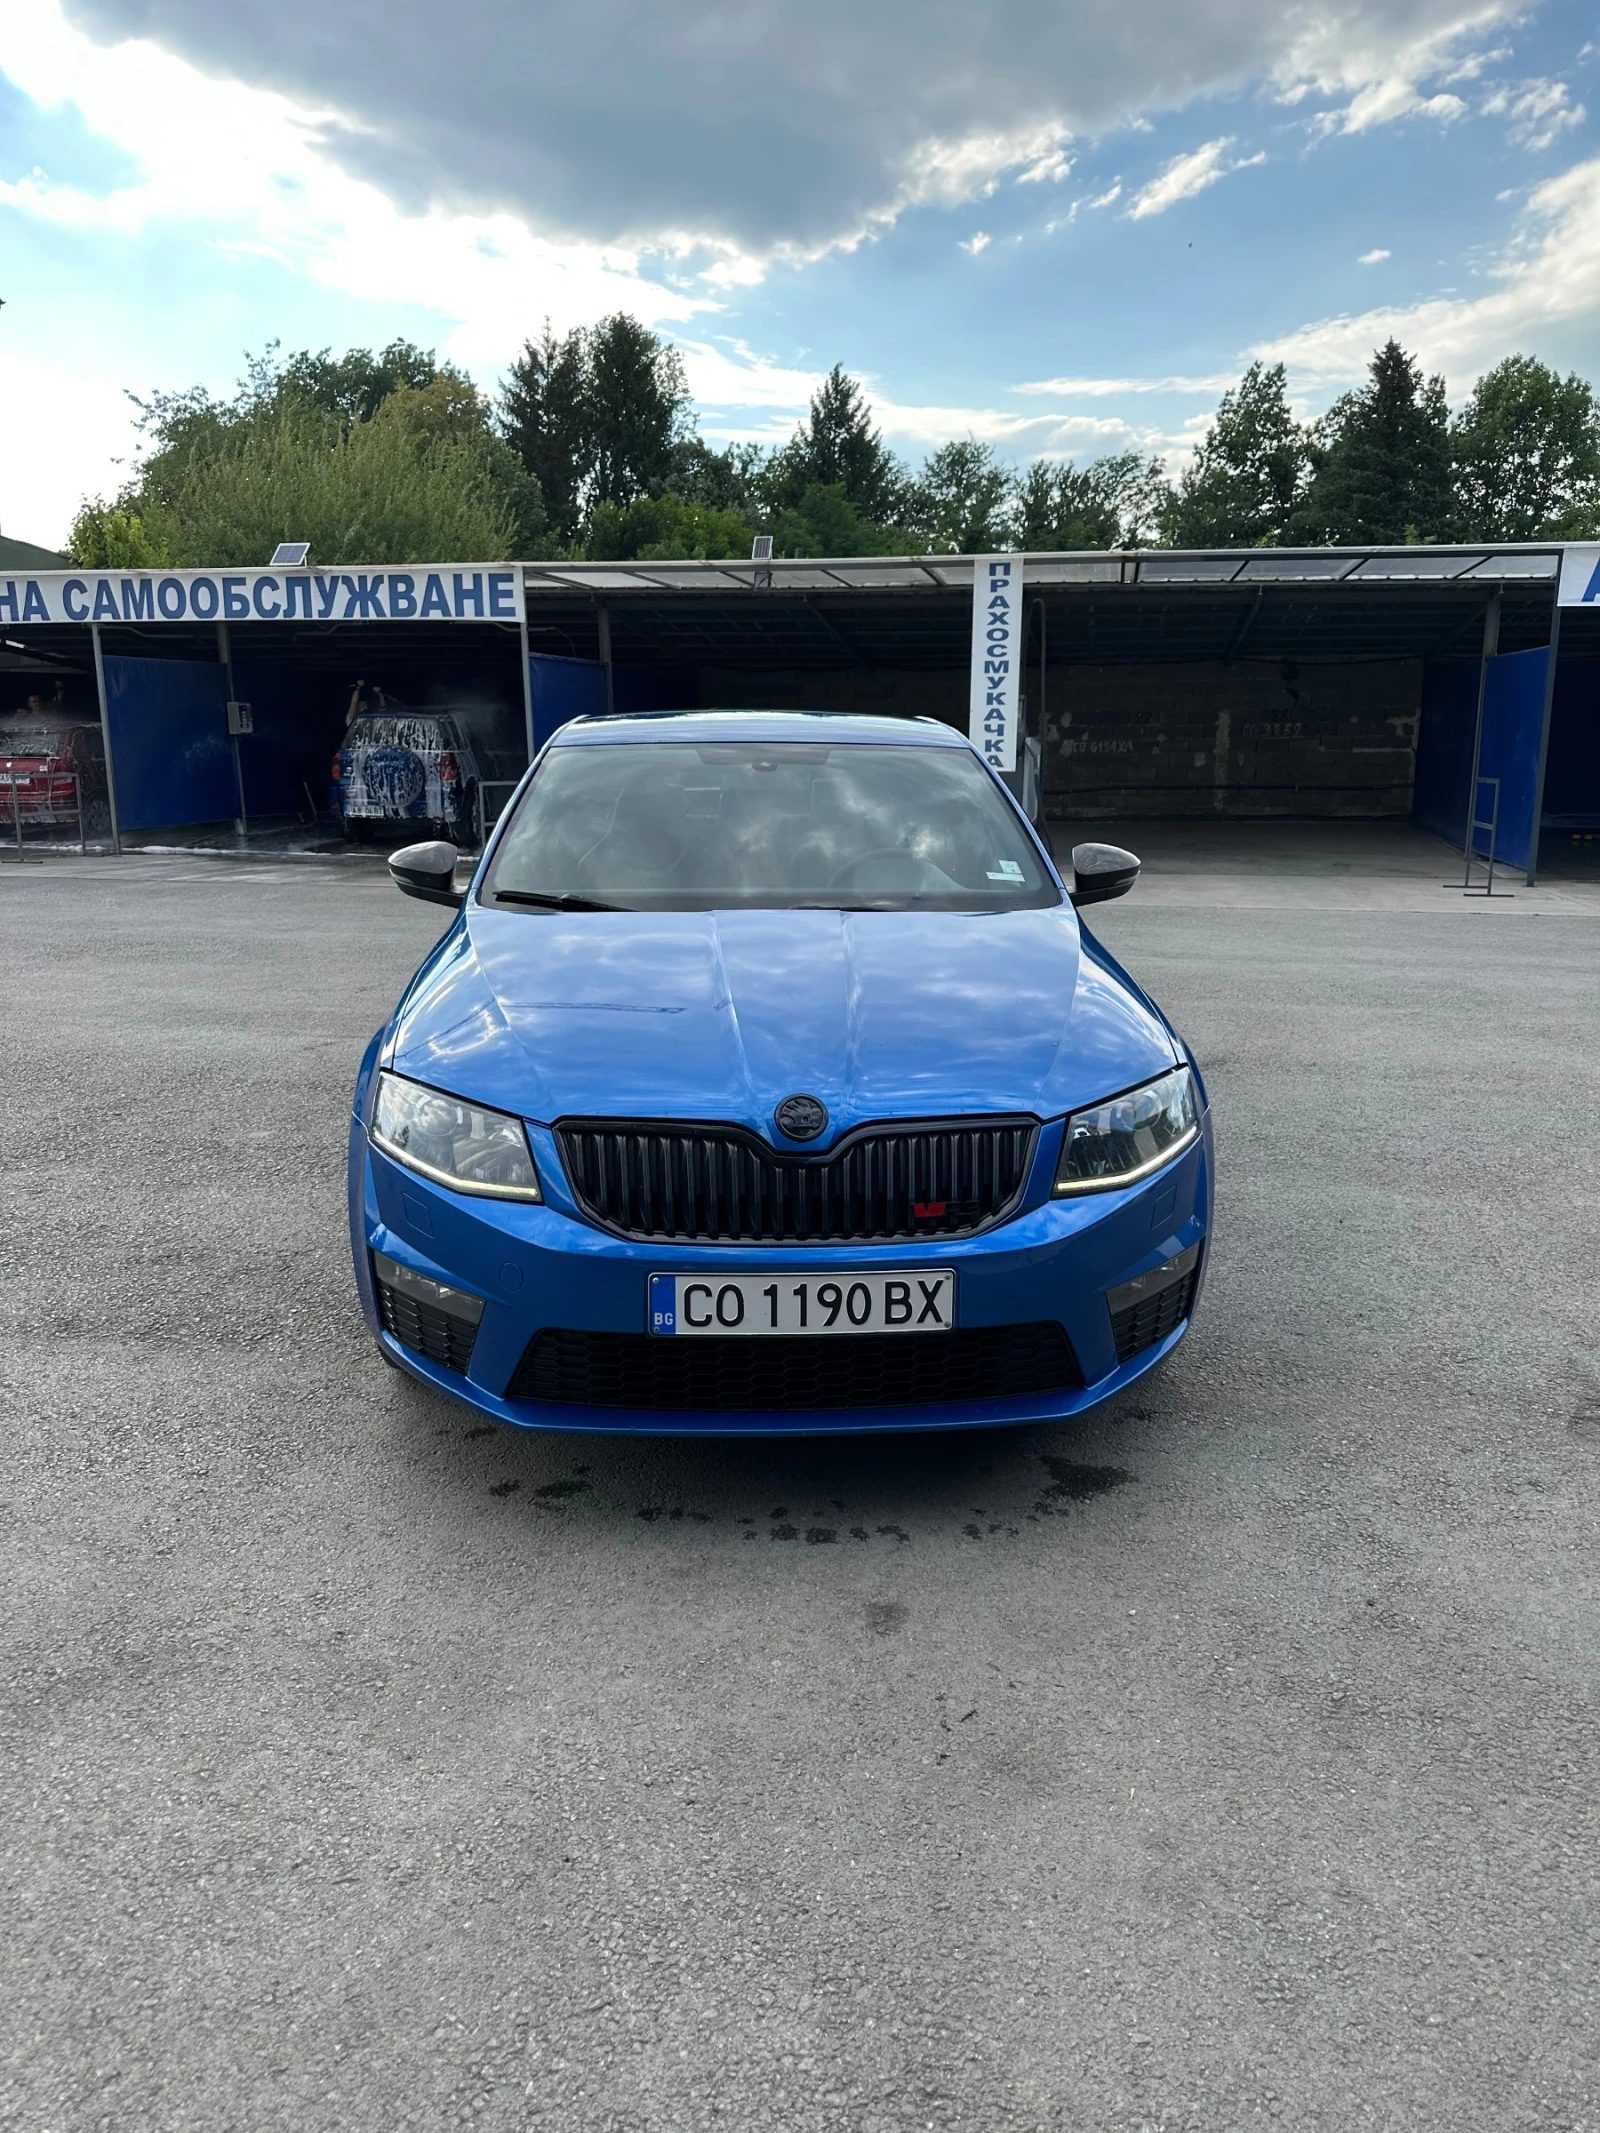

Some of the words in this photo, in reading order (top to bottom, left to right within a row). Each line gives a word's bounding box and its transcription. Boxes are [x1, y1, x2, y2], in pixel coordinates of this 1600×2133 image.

[62, 573, 516, 620] САМООБСЛУЖВАНЕ
[983, 562, 1011, 768] ПРАХОСМУКАЧКА
[654, 1312, 674, 1325] BG
[683, 1283, 745, 1327] CO
[763, 1282, 872, 1327] 1190
[884, 1279, 944, 1325] BX
